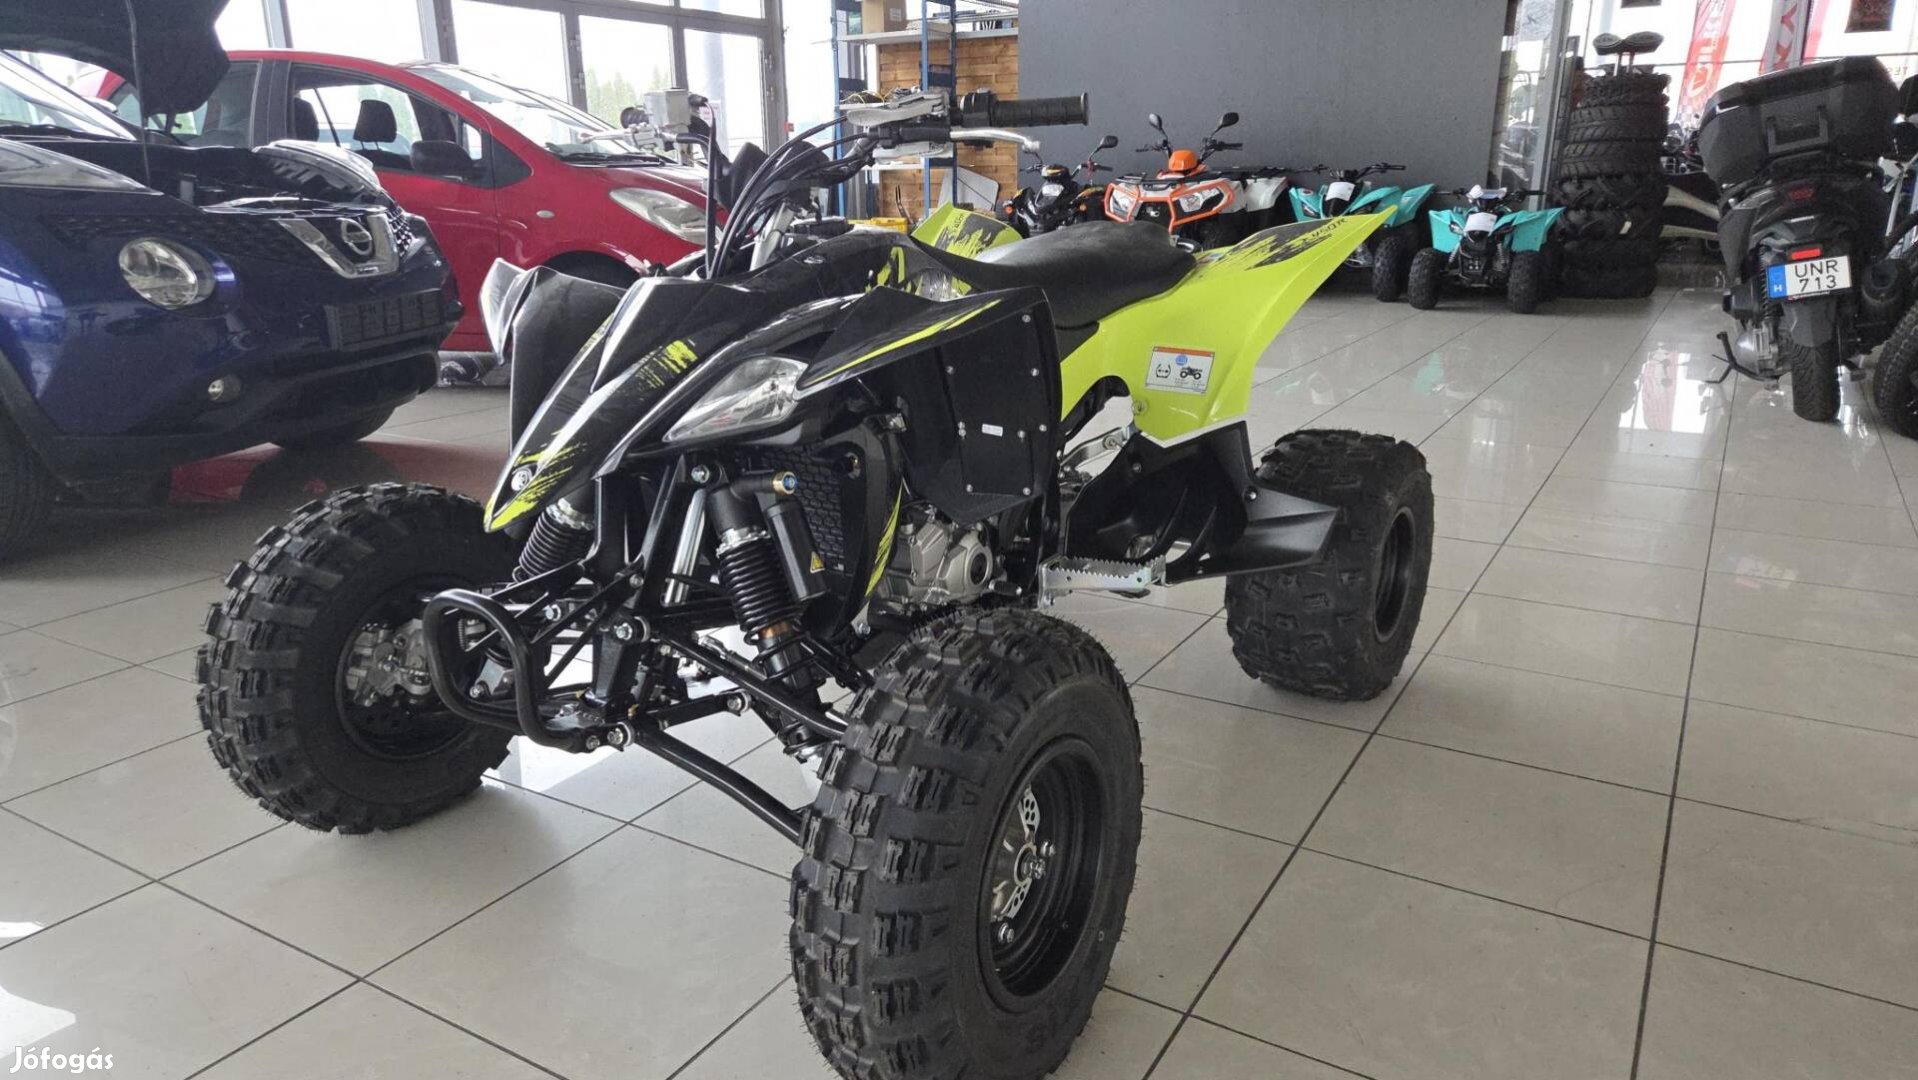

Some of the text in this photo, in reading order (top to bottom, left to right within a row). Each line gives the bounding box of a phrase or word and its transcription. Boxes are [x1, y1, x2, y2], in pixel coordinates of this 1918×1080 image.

[1795, 259, 1839, 278] UNR
[1774, 284, 1782, 292] H
[1799, 275, 1837, 292] 713
